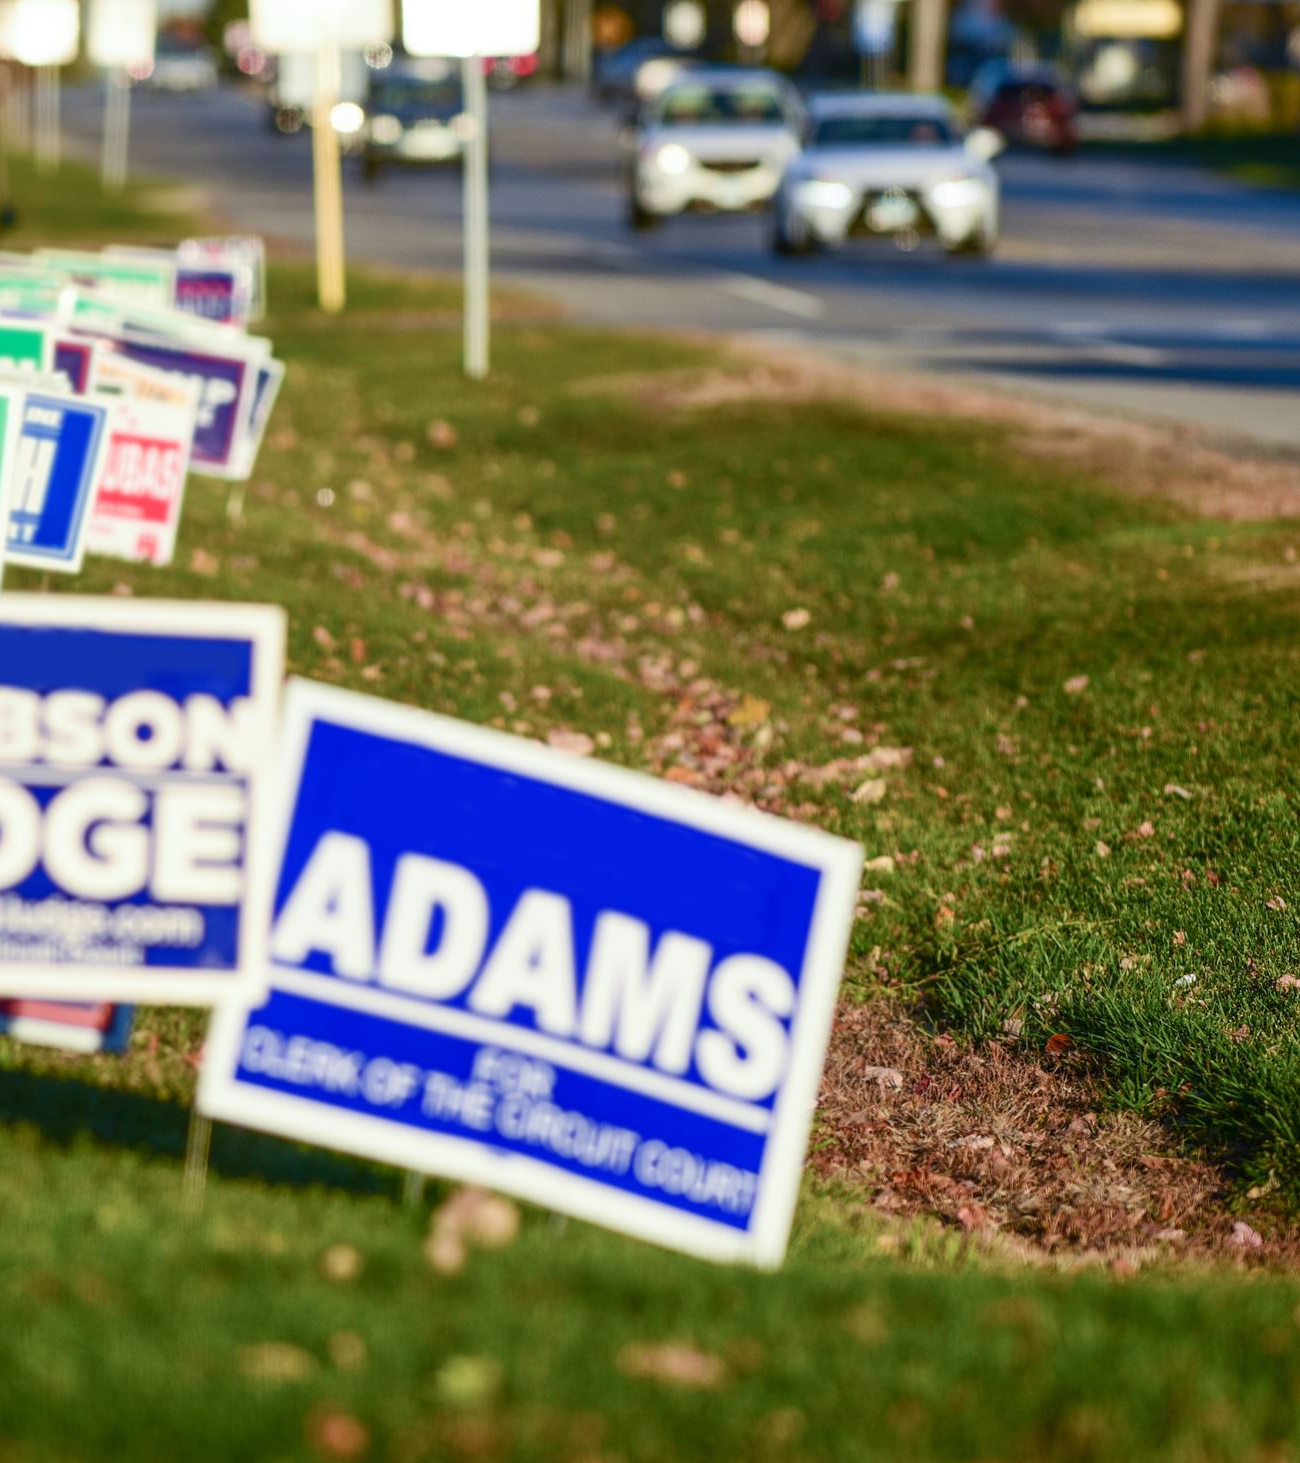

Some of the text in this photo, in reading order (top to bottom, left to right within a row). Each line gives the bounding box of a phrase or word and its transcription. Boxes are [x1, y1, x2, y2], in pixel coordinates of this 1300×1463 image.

[273, 829, 798, 1101] ADAMS
[238, 1025, 757, 1217] CLERK OF THE CIRCUIT COURT
[472, 1045, 556, 1100] FOR
